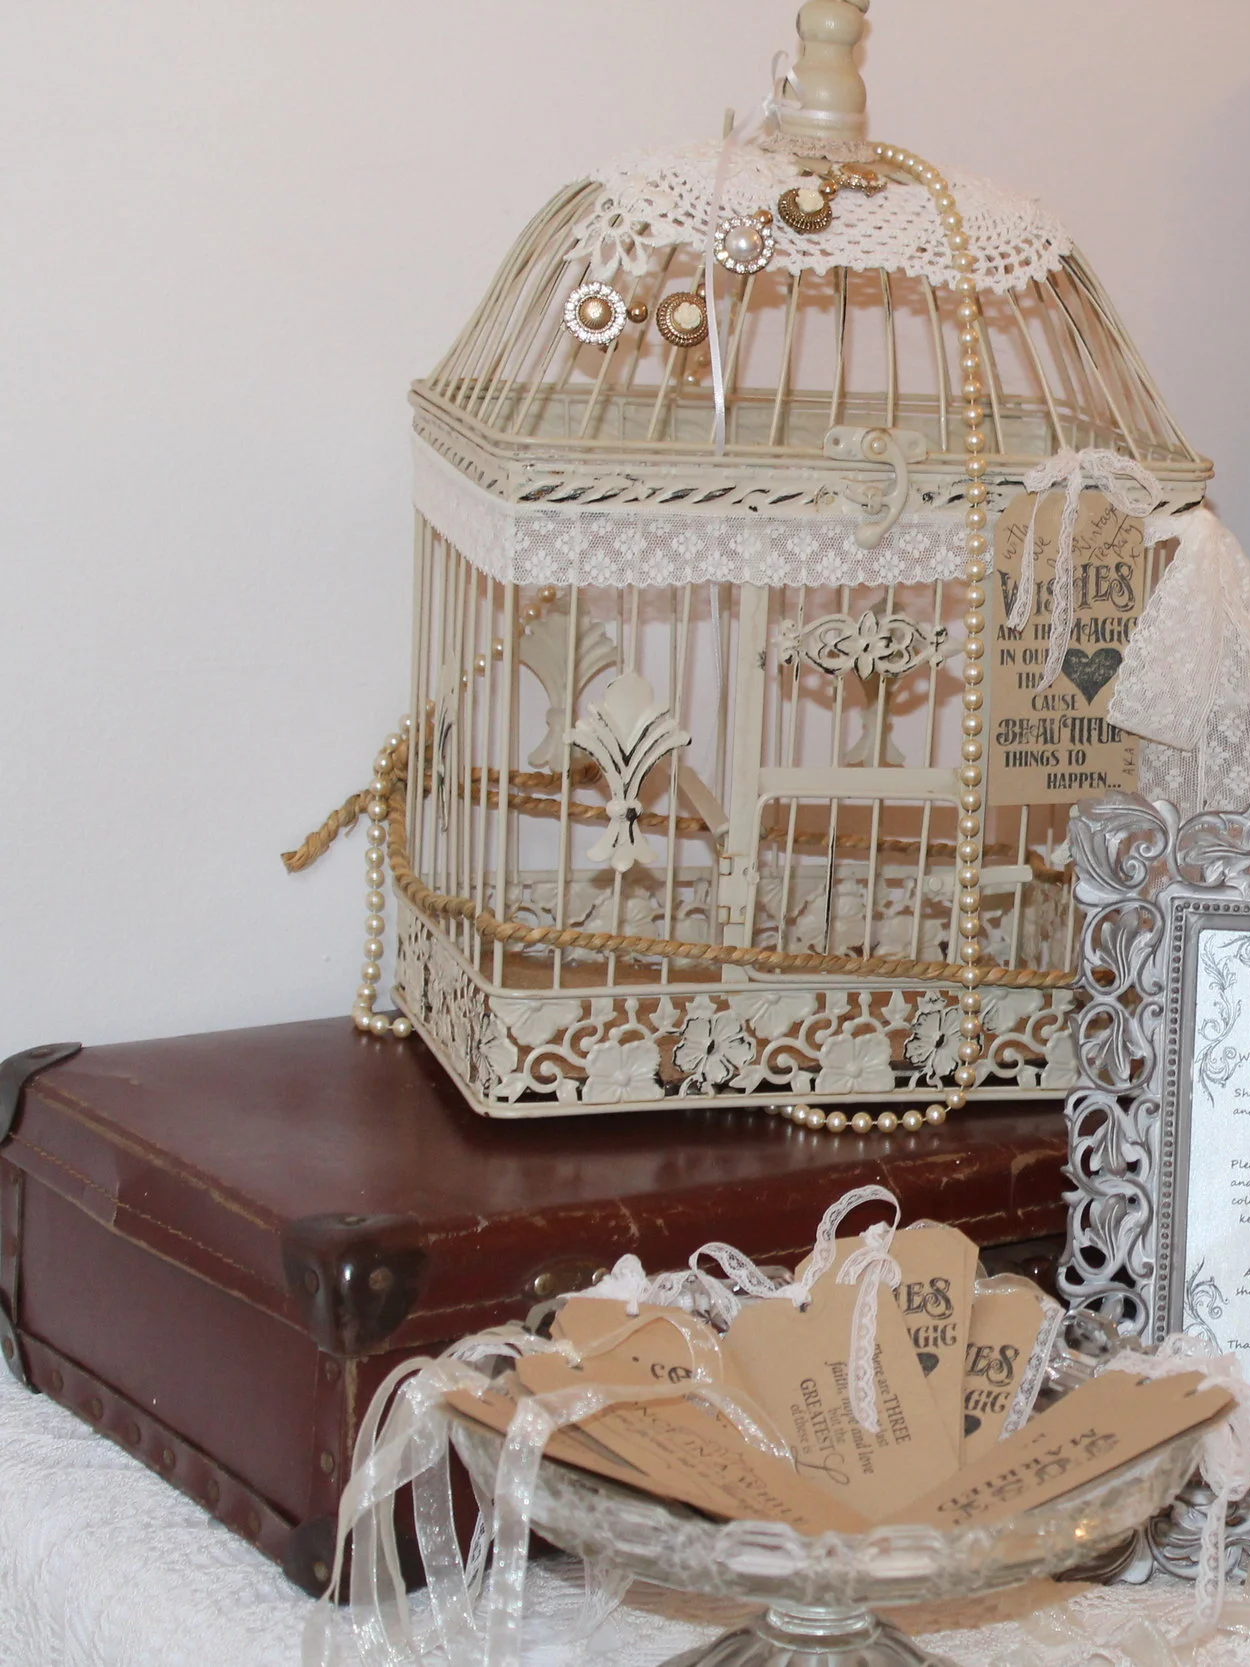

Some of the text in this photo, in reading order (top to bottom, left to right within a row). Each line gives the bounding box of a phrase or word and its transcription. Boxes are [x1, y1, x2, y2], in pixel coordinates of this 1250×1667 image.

[1000, 649, 1016, 666] IN
[1031, 694, 1079, 712] CAUSE
[1004, 750, 1087, 768] THINGS TO
[800, 1378, 836, 1452] GREATEST
[884, 1394, 911, 1445] THREE
[858, 1450, 874, 1474] love
